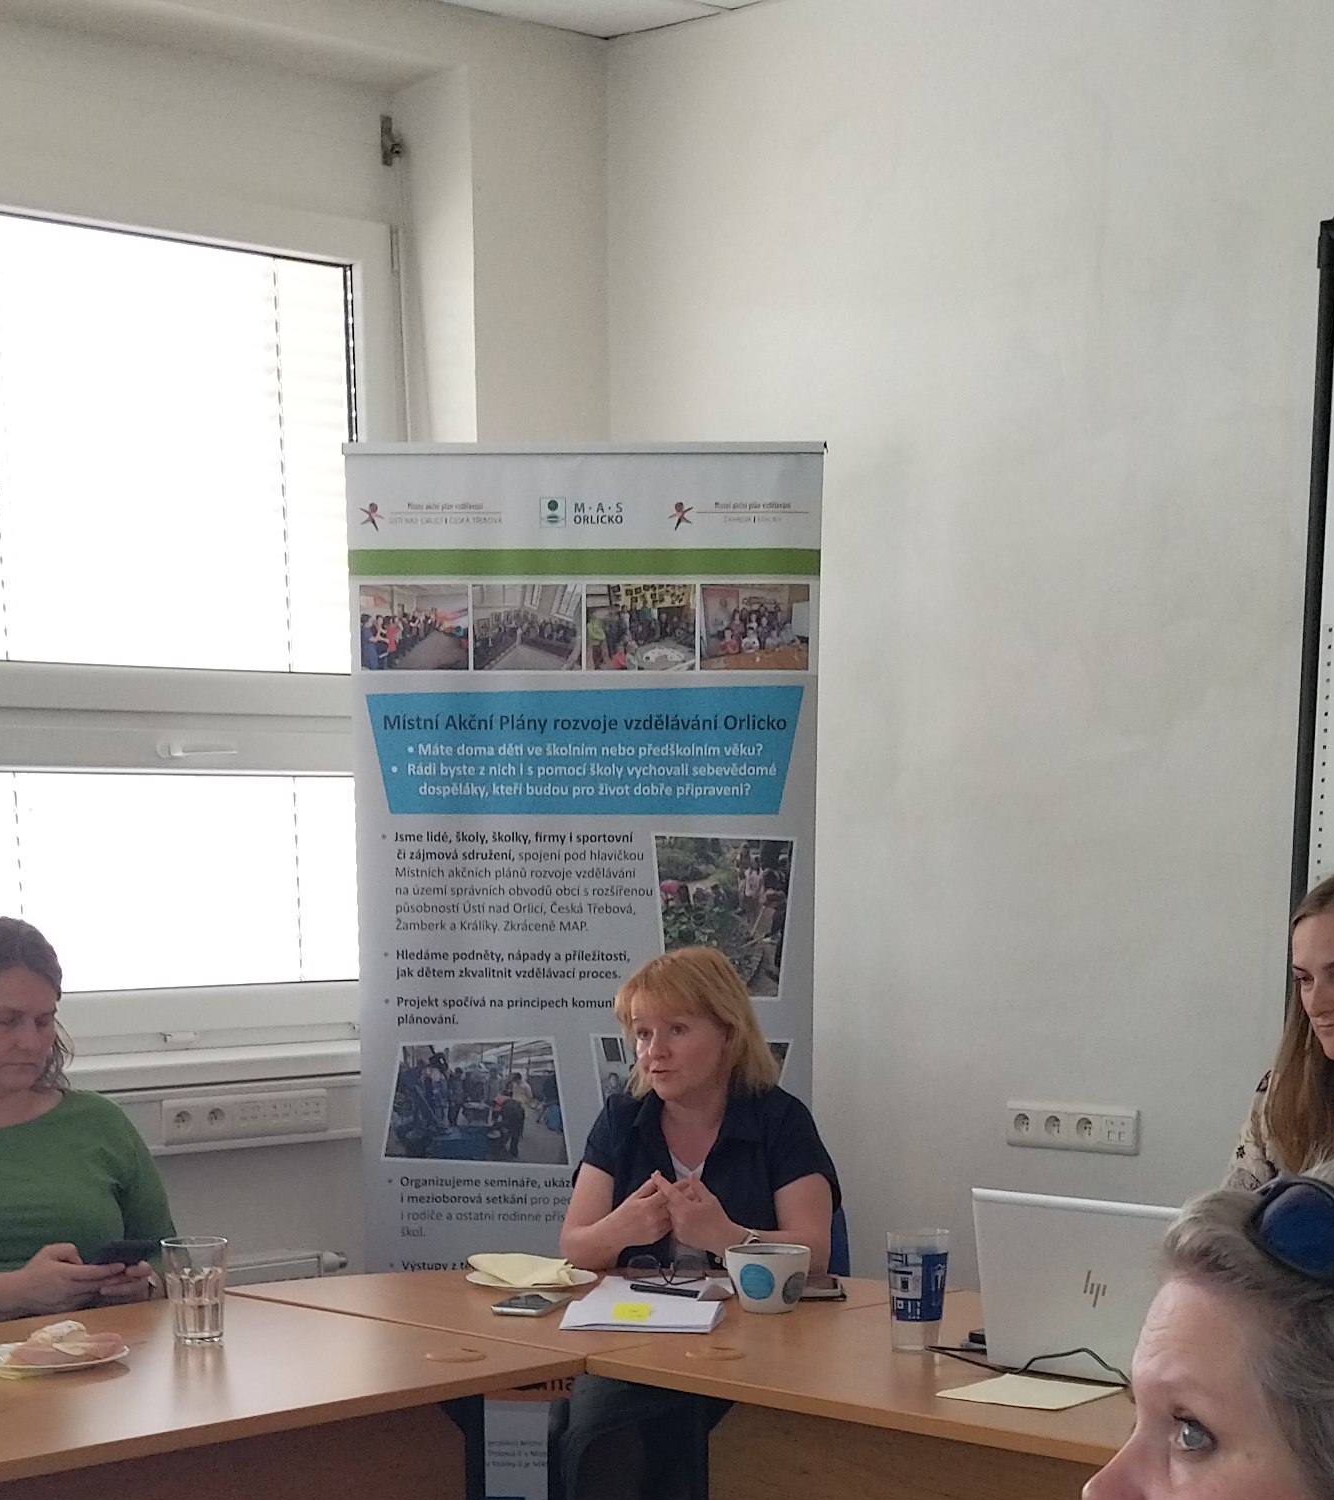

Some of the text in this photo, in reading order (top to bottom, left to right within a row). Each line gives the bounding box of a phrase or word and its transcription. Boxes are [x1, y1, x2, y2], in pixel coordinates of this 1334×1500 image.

[573, 515, 623, 525] ORLICKO
[383, 713, 787, 734] Místní Akční Plány rozvoje vzdělávání Orlicko
[418, 742, 764, 759] Máte doma děti ve školním nebo předškolním věku?
[407, 762, 437, 776] Rádi
[440, 763, 476, 779] byste
[489, 763, 517, 776] nich
[537, 762, 586, 779] pomocí
[590, 762, 624, 779] školy
[626, 763, 689, 779] vychovali
[692, 762, 777, 776] sebevědomé
[418, 782, 752, 799] dospěláky, kteří budou pro život dobře připraveni?
[394, 832, 423, 842] Jsme
[426, 831, 452, 844] lidé,
[455, 831, 488, 845] školy,
[492, 831, 531, 845] školky,
[534, 831, 566, 845] firmy
[576, 832, 634, 845] sportovní
[396, 848, 644, 863] či zájmová sdružení, spojení pod hlavičkou
[395, 866, 636, 881] Místních akčních plánů rozvoje vzdělávání
[395, 886, 409, 896] na
[412, 884, 447, 896] území
[450, 884, 505, 897] správních
[508, 884, 552, 896] obvodů
[555, 885, 580, 896] obcí
[592, 885, 653, 897] rozšířenou
[395, 900, 636, 915] působností Ústí nad Orlicí, Česká Třebová,
[395, 918, 446, 931] Žamberk
[460, 920, 500, 934] Králíky.
[503, 920, 556, 932] Zkráceně
[559, 921, 589, 932] MAP.
[396, 949, 449, 960] Hledáme
[452, 949, 504, 963] podněty,
[507, 949, 552, 963] nápady
[565, 950, 630, 963] příležitosti,
[396, 967, 622, 981] jak dětem zkvalitnit vzdělávací proces.
[396, 996, 616, 1010] Projekt spočívá na principech komuni
[397, 1013, 459, 1027] plánování.
[400, 1176, 572, 1189] Organizujeme semináře, ukáz
[407, 1193, 483, 1204] mezioborová
[486, 1194, 527, 1205] setkání
[530, 1197, 550, 1206] pro
[407, 1210, 443, 1221] rodiče
[455, 1210, 495, 1221] ostatní
[498, 1211, 541, 1222] rodinné
[400, 1226, 426, 1238] škol.
[1083, 1270, 1107, 1307] hp
